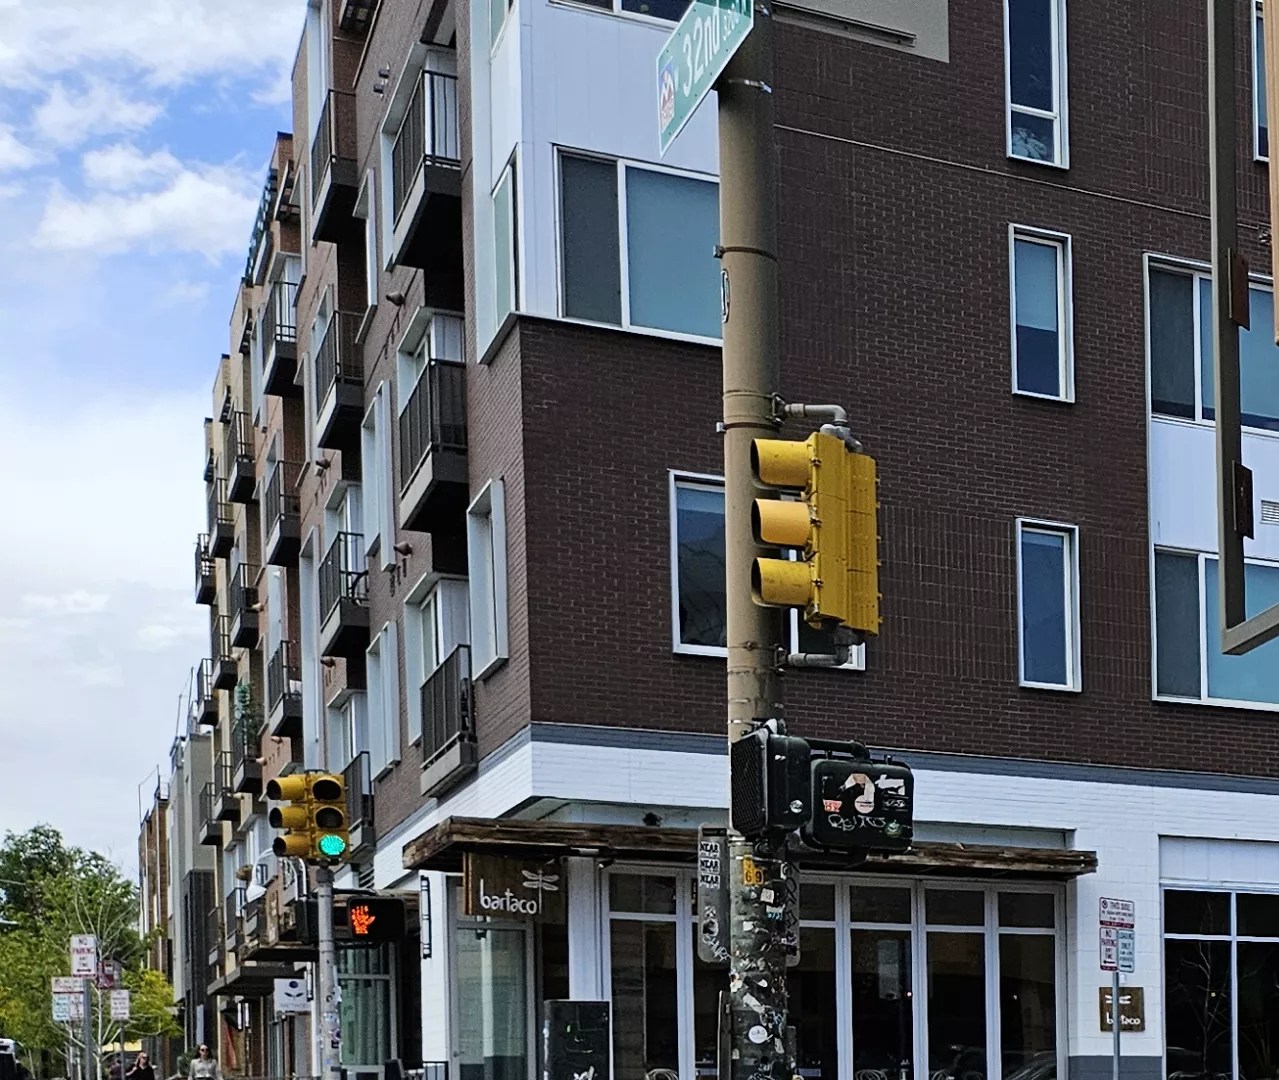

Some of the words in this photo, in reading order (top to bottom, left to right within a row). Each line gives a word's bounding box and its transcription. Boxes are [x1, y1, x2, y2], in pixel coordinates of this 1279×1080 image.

[683, 0, 720, 97] 32nd
[480, 878, 537, 914] bartaco
[1106, 1011, 1141, 1025] btaco
